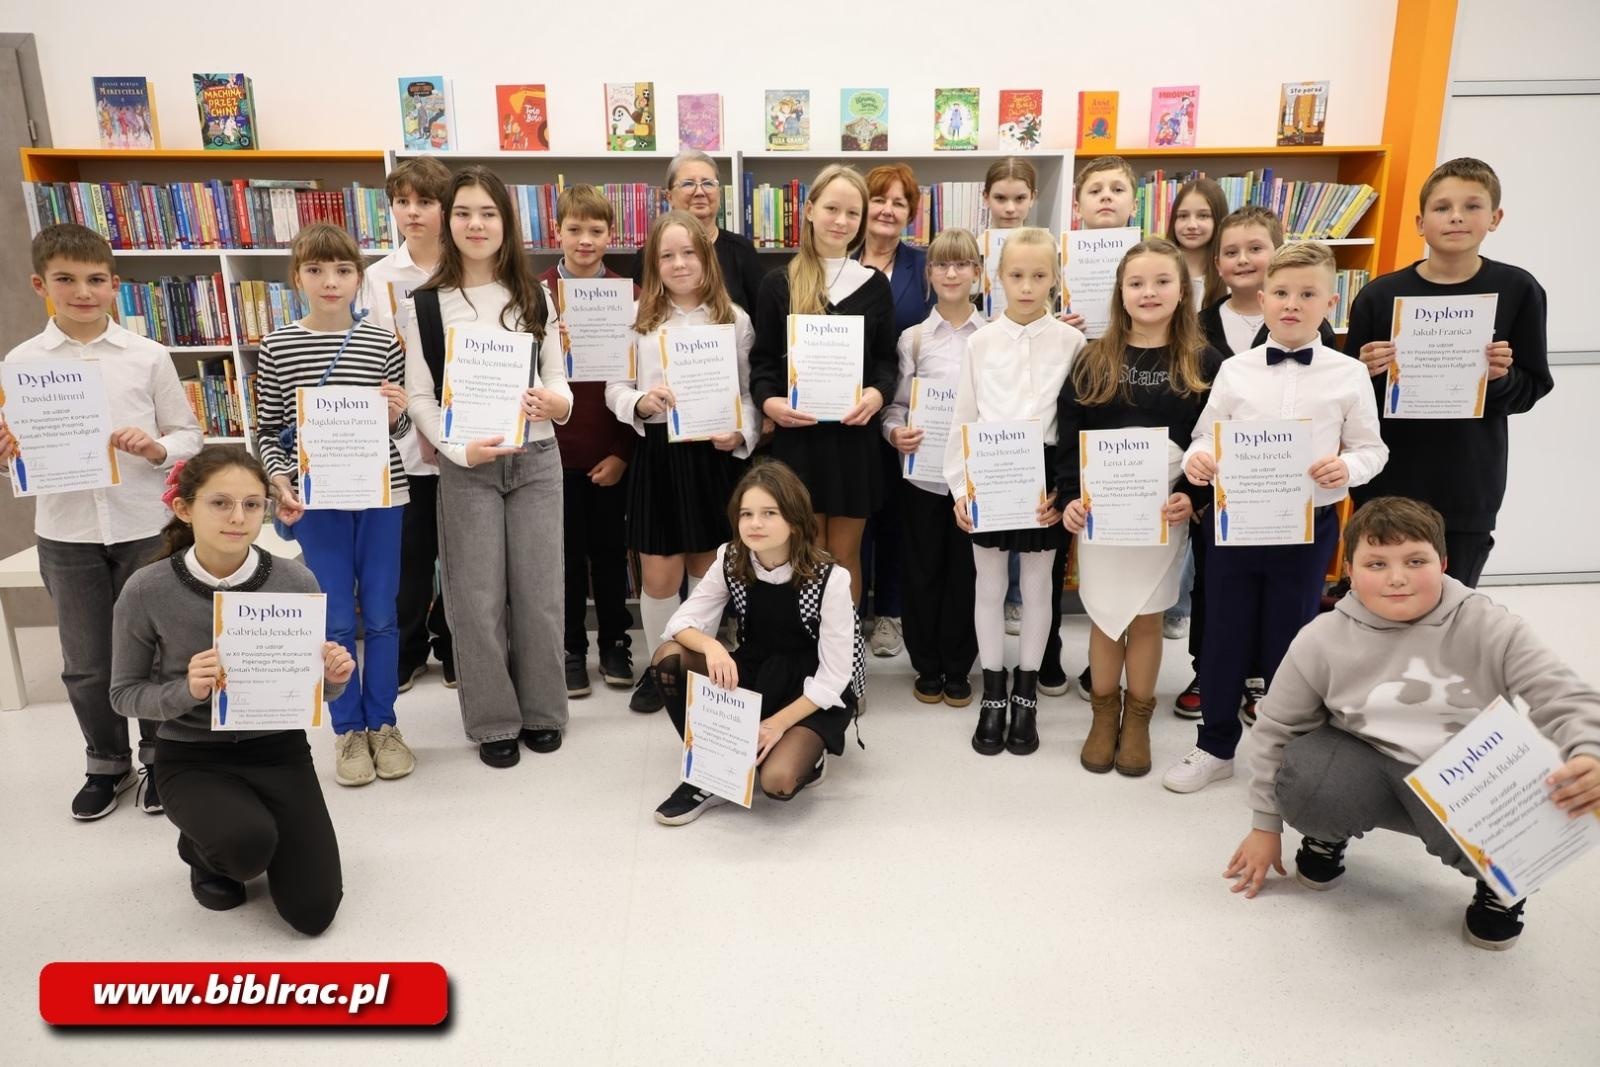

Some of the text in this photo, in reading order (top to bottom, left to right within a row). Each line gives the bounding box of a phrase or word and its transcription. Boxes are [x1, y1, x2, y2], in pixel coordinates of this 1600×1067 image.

[209, 98, 238, 108] PRZEZ
[210, 106, 238, 116] CHINY
[1078, 238, 1123, 252] Dyplom
[574, 288, 617, 300] Dyplom
[1415, 307, 1474, 322] Dyplom
[806, 324, 848, 335] Dyplom
[465, 338, 514, 353] Dyplom
[675, 339, 718, 353] Dyplom
[18, 370, 82, 388] Dyplom
[22, 394, 52, 404] Dawid
[316, 398, 368, 412] Dyplom
[308, 418, 350, 427] Magdalena
[979, 430, 1025, 444] Dyplom
[1234, 430, 1292, 446] Dyplom
[1099, 439, 1149, 453] Dyplom
[239, 604, 302, 621] Dyplom
[227, 627, 312, 636] Gabriela Jenderko
[702, 686, 745, 709] Dyplom
[1439, 731, 1503, 785] Dyplom
[1449, 770, 1500, 813] Franciszek
